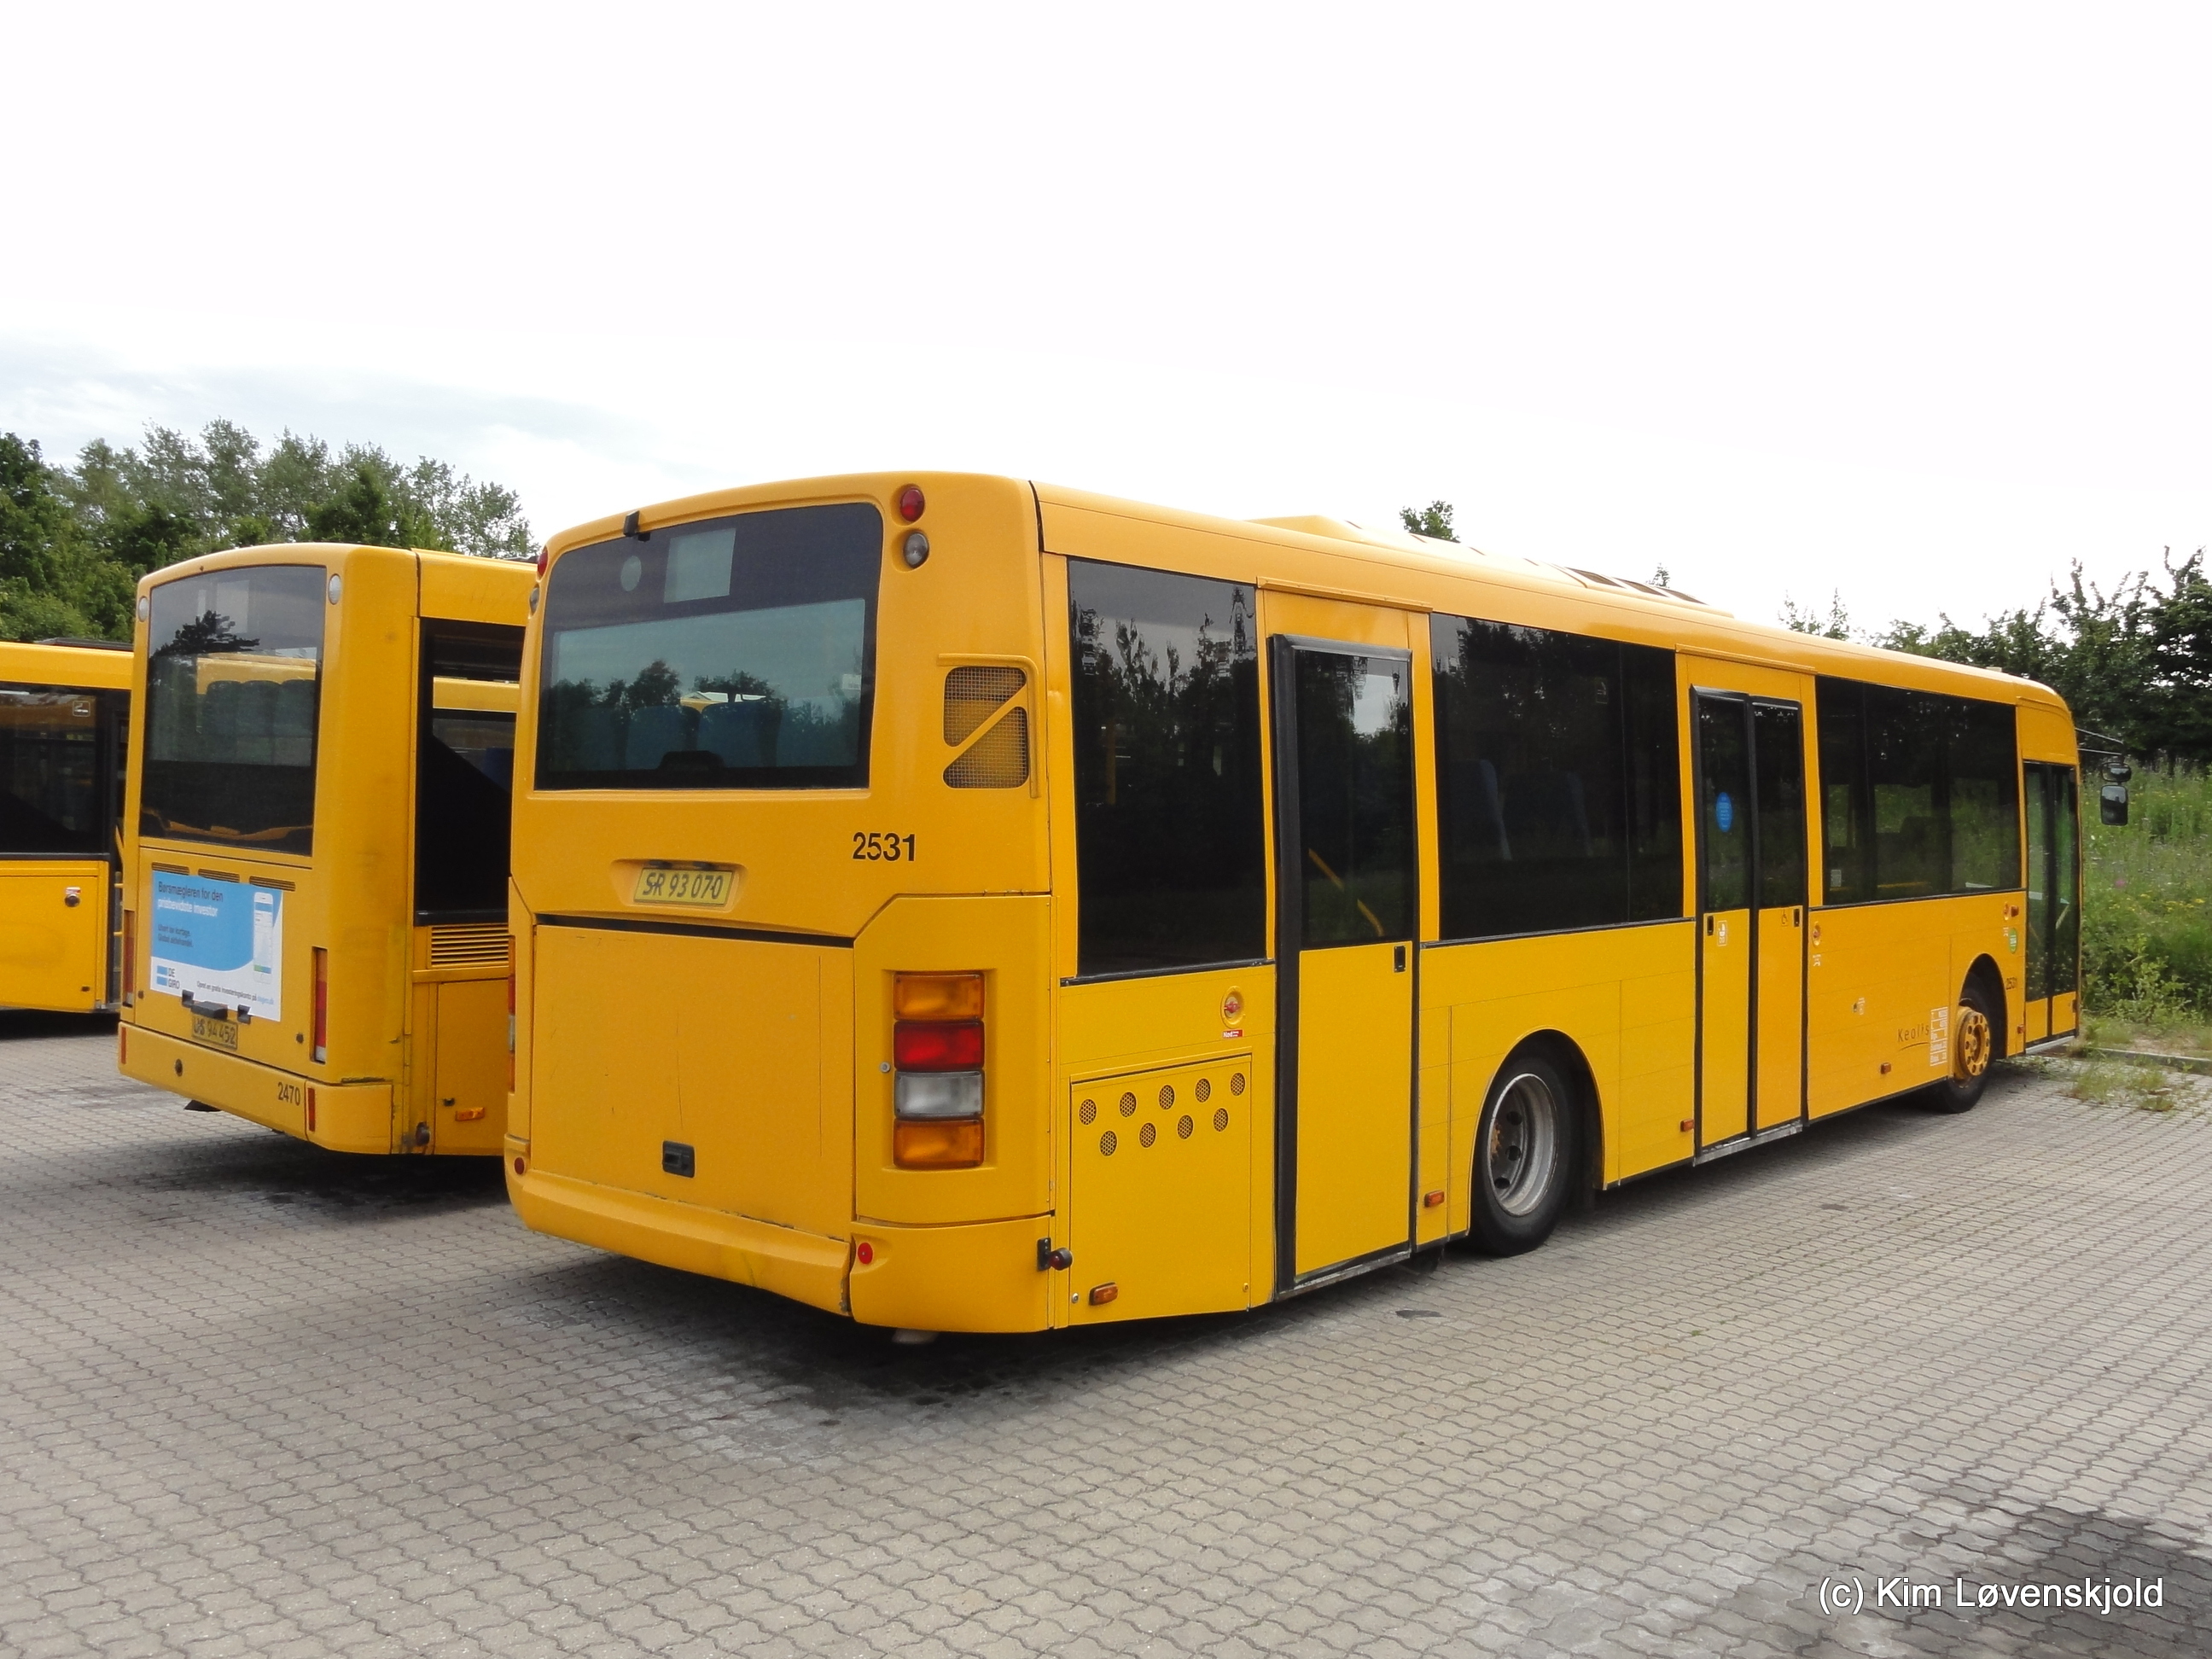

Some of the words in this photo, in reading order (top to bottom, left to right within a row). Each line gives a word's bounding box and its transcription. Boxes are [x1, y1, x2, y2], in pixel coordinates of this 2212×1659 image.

[853, 831, 916, 862] 2531
[158, 881, 201, 899] Børsmægleren
[201, 887, 211, 900] for
[212, 888, 224, 902] den
[643, 872, 663, 897] SR
[669, 874, 689, 898] 93
[690, 874, 724, 900] 070
[168, 968, 176, 978] DE
[168, 979, 180, 990] GIRO
[207, 1022, 218, 1038] 94
[218, 1023, 236, 1043] 452
[1897, 1023, 1930, 1043] Keolis
[277, 1082, 300, 1106] 2470
